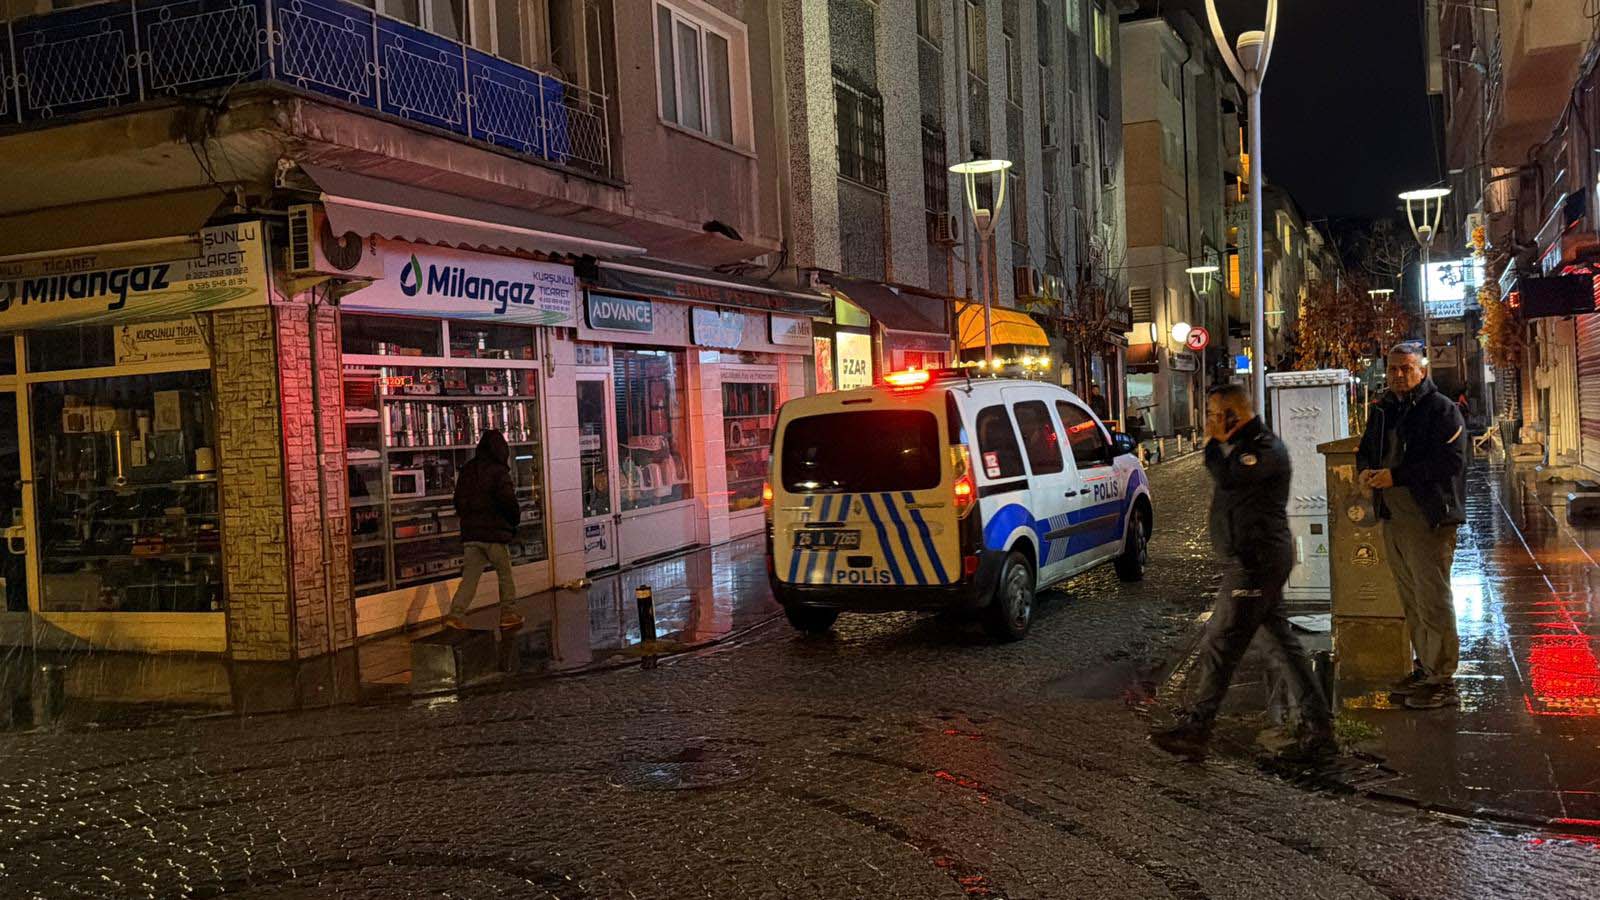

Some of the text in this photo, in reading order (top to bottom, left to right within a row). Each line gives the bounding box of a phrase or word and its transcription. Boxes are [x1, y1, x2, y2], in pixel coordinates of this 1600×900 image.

[21, 265, 170, 310] Milangaz
[427, 264, 535, 314] Milangaz
[592, 300, 651, 323] ADVANCE
[1094, 476, 1119, 502] POLİS
[836, 566, 891, 584] POLİS
